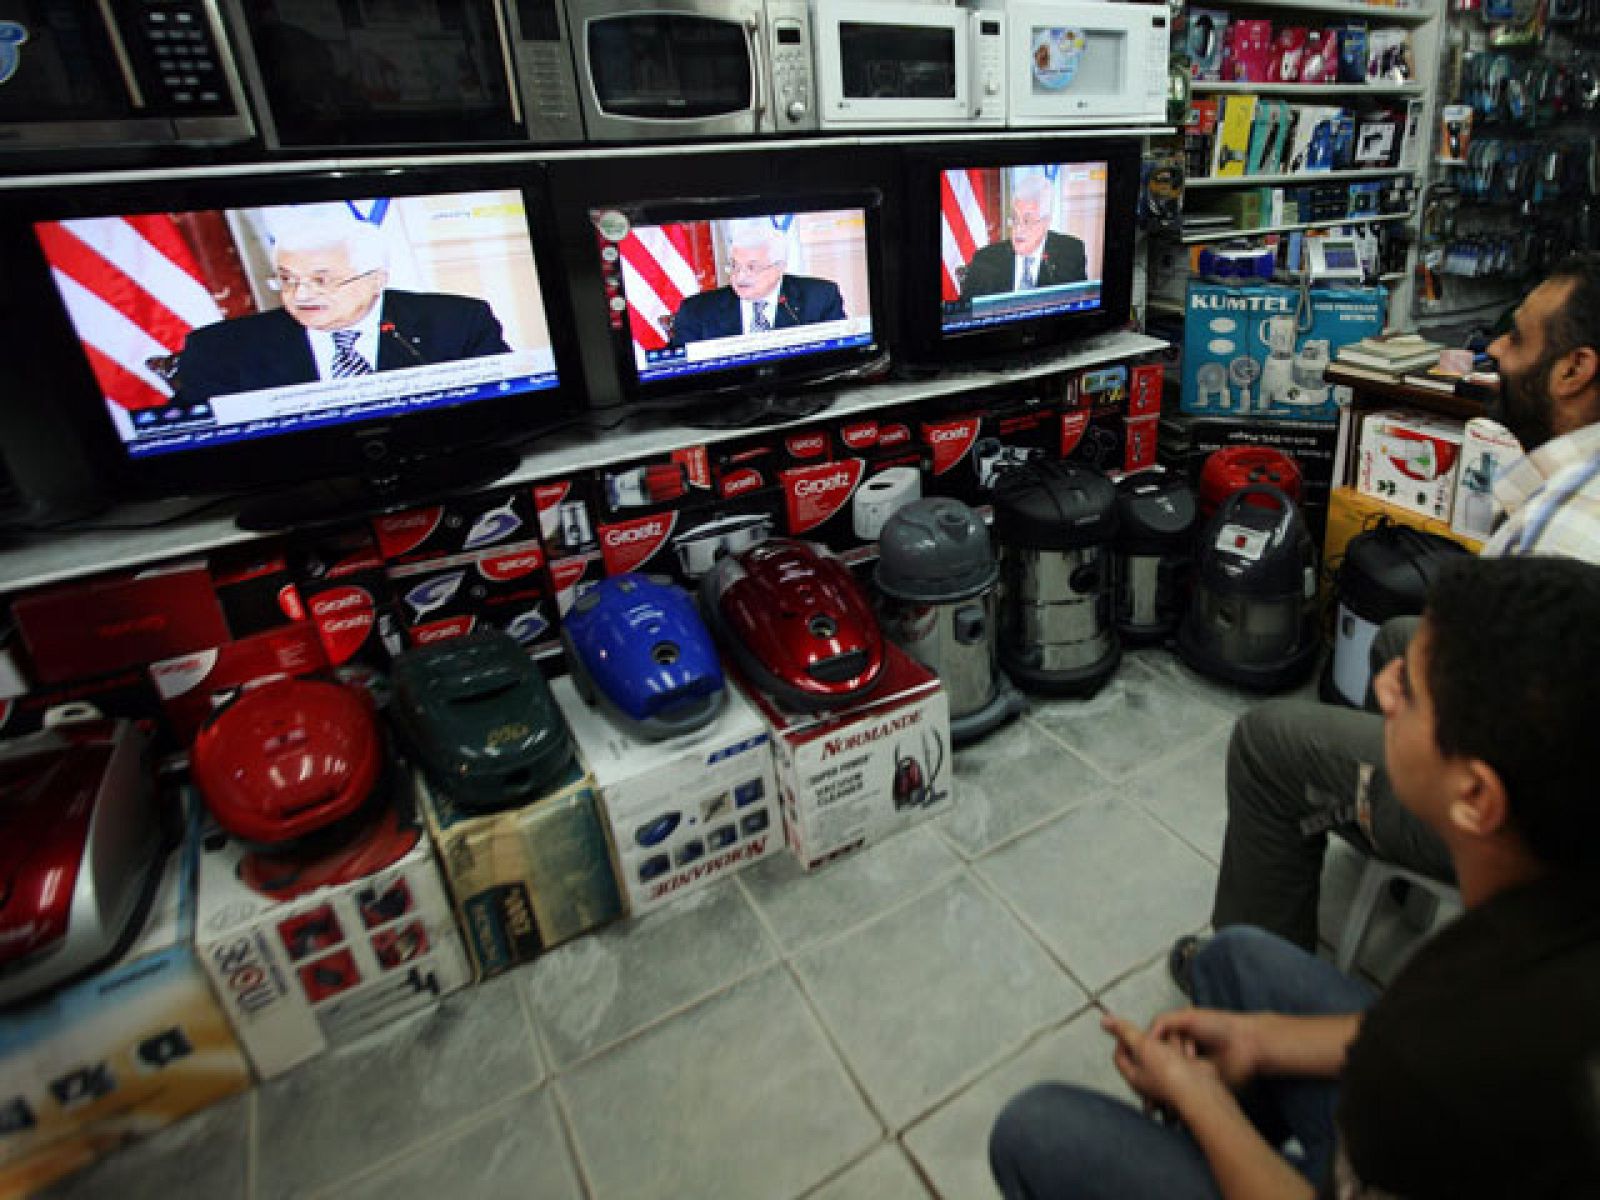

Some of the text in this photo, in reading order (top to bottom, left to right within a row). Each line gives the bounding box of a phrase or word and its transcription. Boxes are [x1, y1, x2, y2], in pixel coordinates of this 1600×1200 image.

[795, 472, 850, 497] Graetz
[604, 521, 663, 547] Graetz
[821, 708, 923, 762] NORMANDE
[650, 836, 769, 900] NORMANDE
